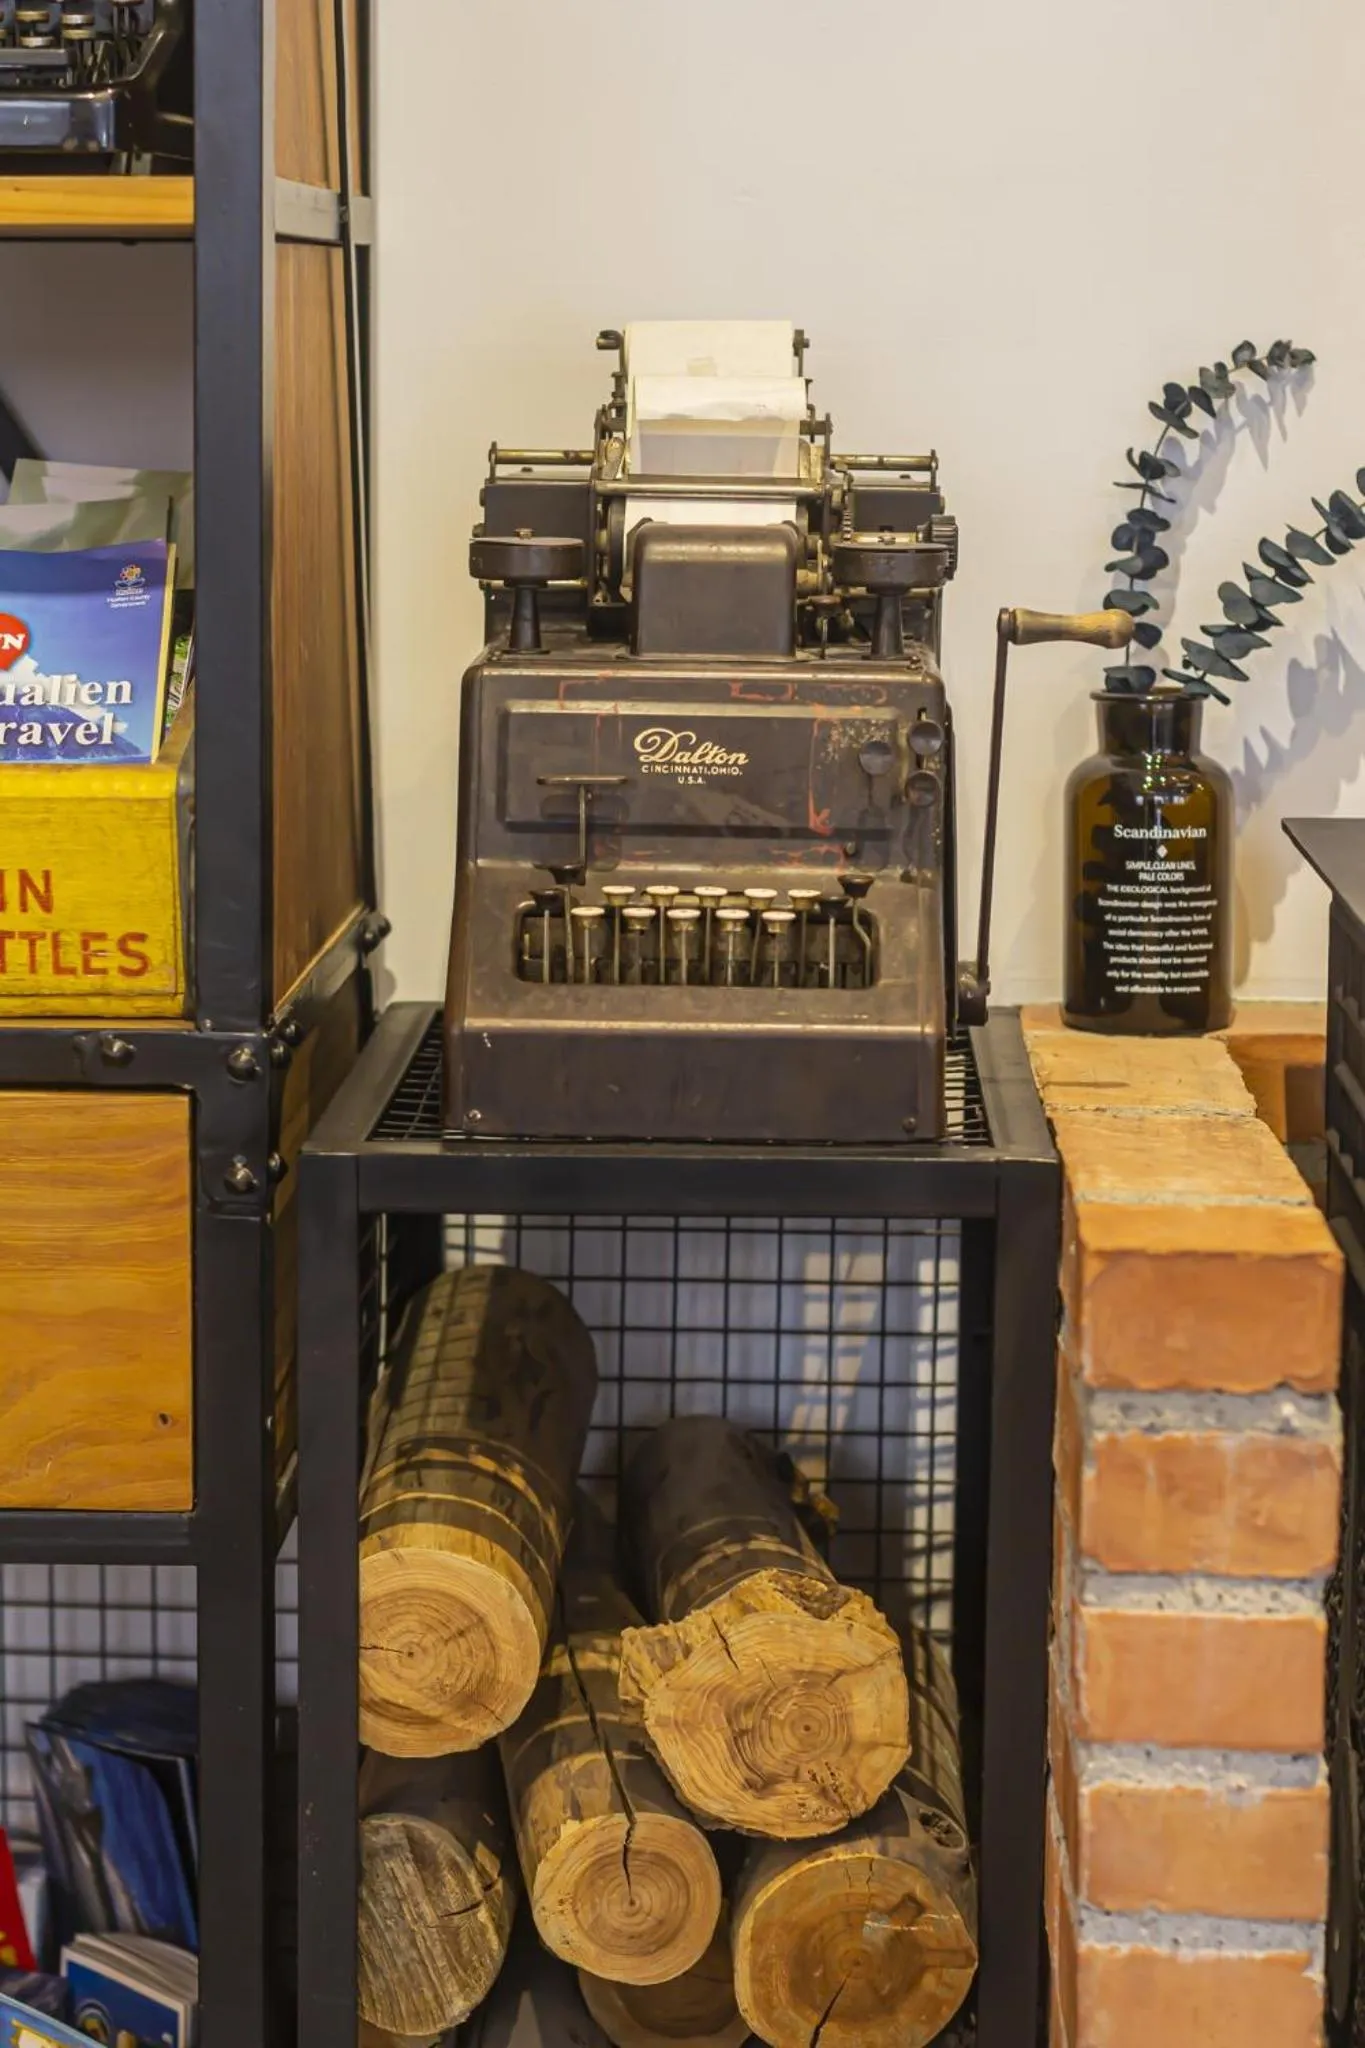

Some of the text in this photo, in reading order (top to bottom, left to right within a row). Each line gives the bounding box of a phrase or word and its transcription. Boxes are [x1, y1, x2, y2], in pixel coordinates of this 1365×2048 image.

[633, 727, 749, 765] Dalton
[1113, 824, 1207, 839] Scandinavian
[1138, 872, 1185, 881] PALE COLORS
[1106, 884, 1118, 893] THE
[1120, 885, 1169, 894] IDEOLOGICAL
